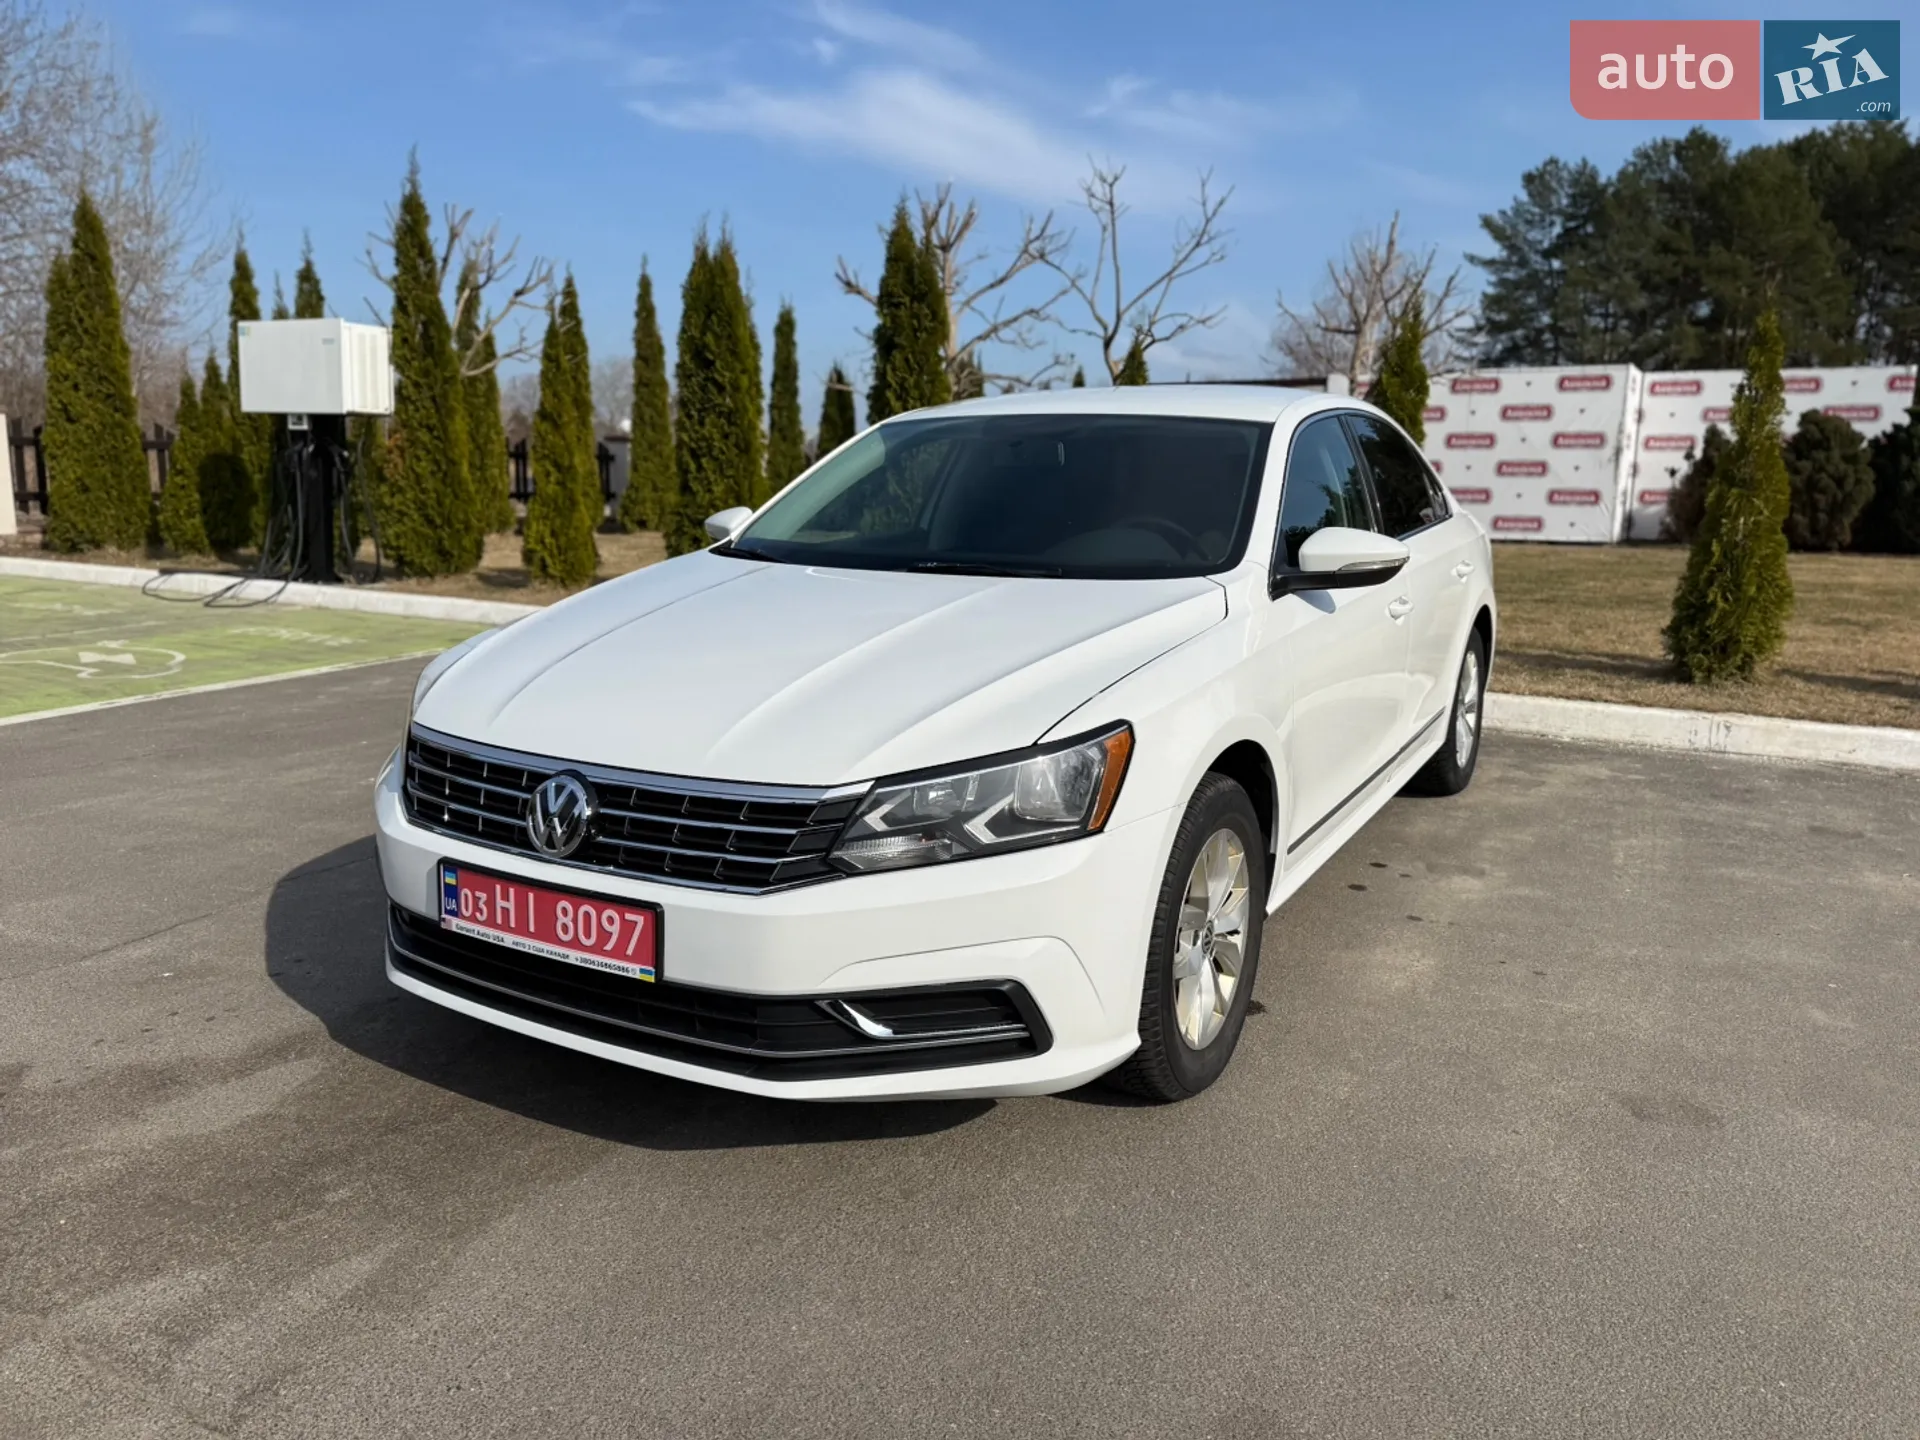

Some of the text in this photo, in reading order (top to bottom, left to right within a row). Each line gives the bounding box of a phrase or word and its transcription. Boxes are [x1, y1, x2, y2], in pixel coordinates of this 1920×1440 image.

[445, 897, 458, 912] UA
[460, 888, 488, 922] 03
[555, 900, 645, 956] 8097
